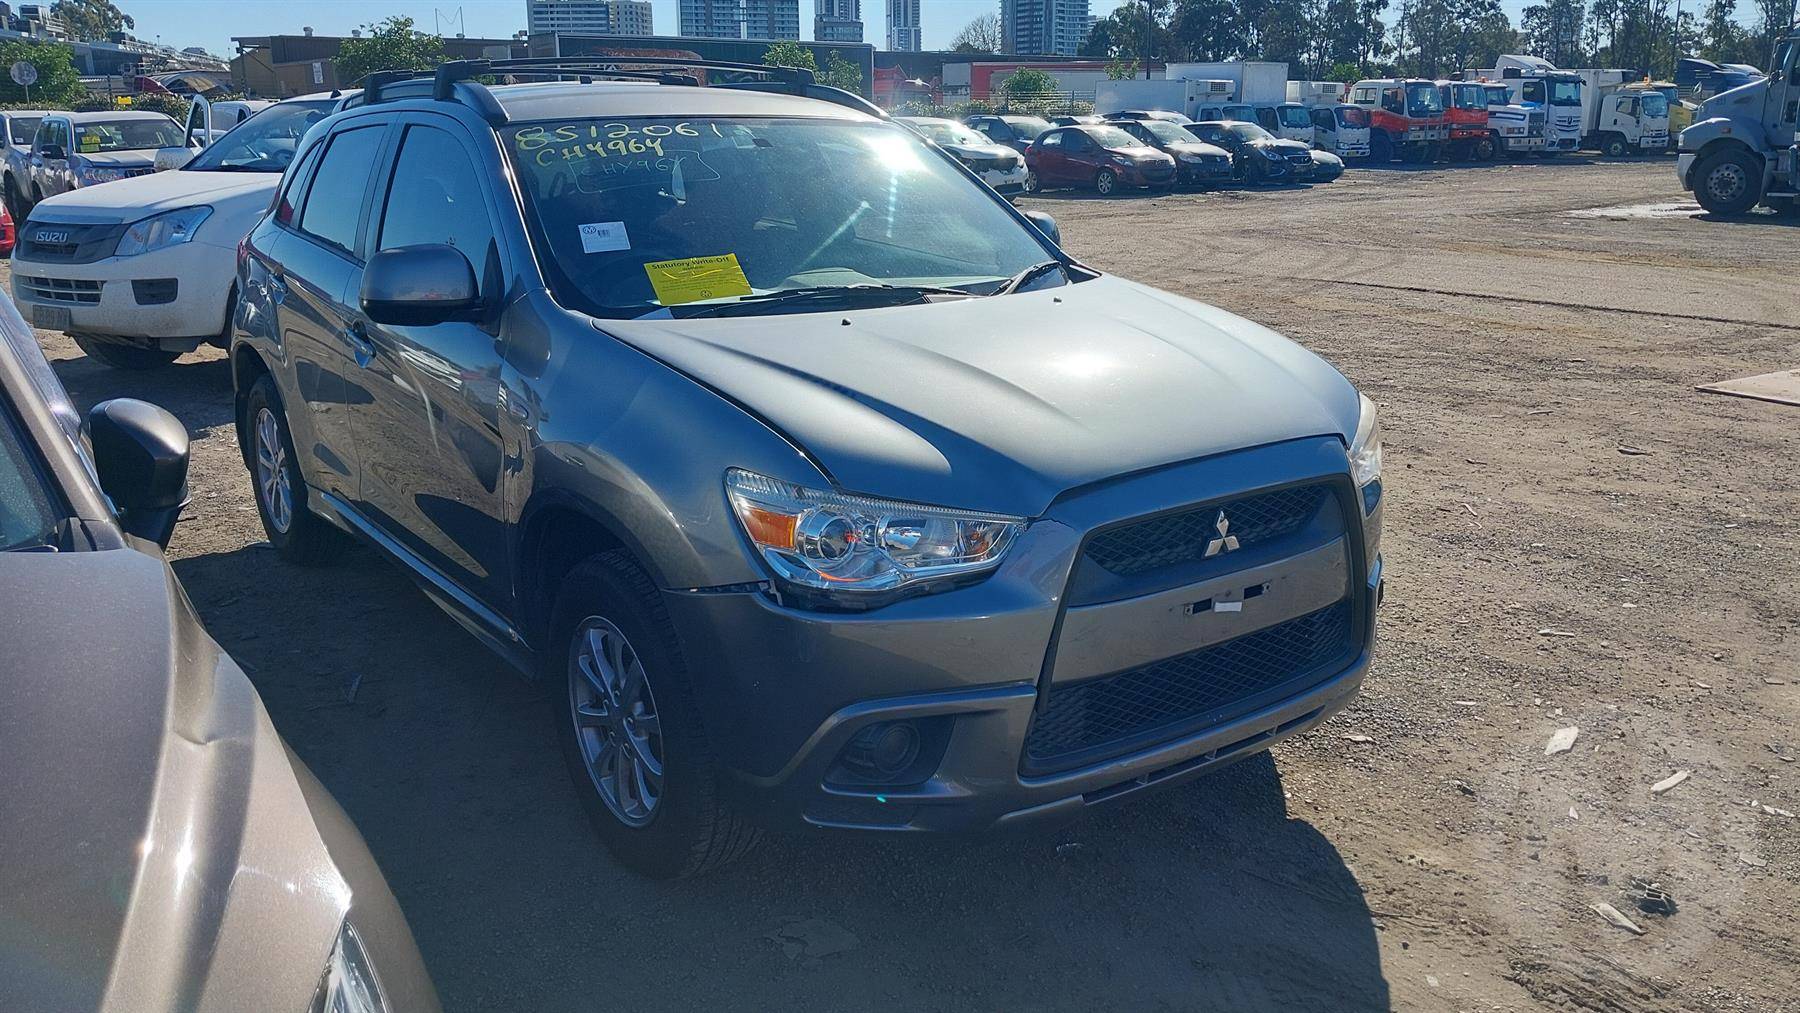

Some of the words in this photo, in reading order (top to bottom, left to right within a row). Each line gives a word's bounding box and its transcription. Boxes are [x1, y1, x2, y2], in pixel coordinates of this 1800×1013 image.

[35, 231, 68, 243] ISUZU
[651, 261, 690, 270] Statutory
[691, 256, 729, 266] Write-Off
